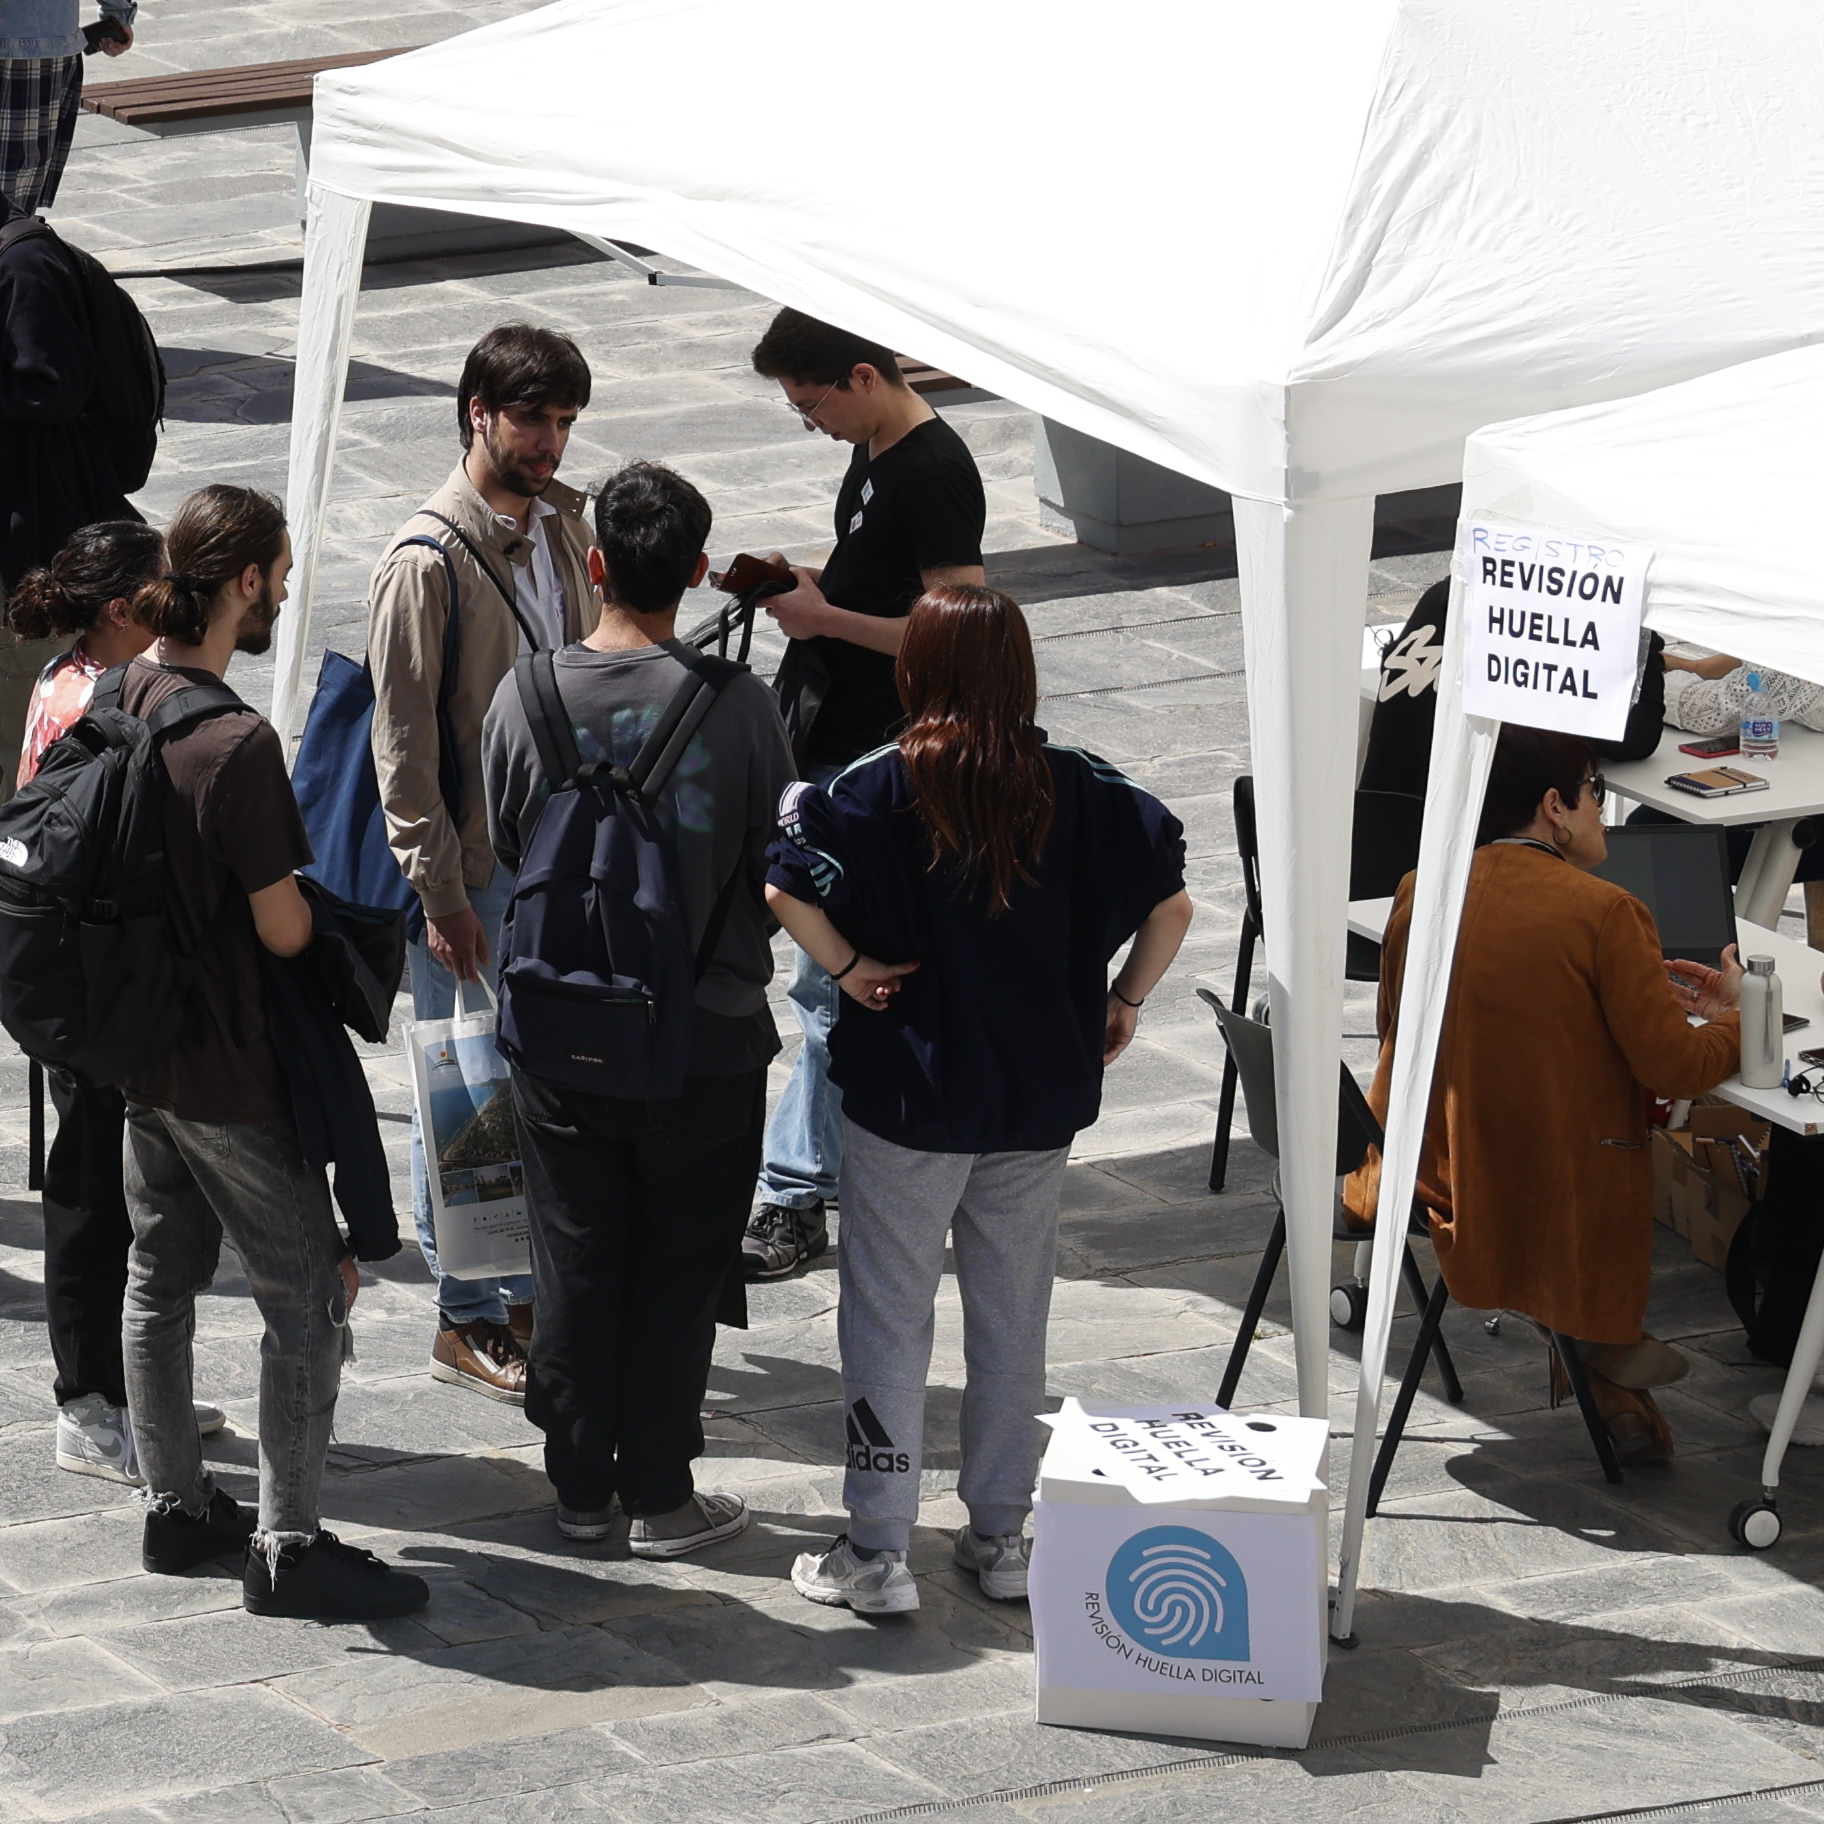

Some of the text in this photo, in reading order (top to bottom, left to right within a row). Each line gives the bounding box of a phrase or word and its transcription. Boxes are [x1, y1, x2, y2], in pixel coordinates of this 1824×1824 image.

[1472, 527, 1624, 568] REGISTRO
[1482, 556, 1625, 605] REVISIÓN
[1488, 605, 1600, 651] HUELLA
[1487, 653, 1598, 700] DIGITAL
[571, 1054, 603, 1063] EASTPAK
[847, 1442, 911, 1473] idas
[1089, 1422, 1179, 1481] DIGITAL
[1134, 1419, 1225, 1477] HUELLA
[1171, 1411, 1284, 1483] REVISIÓN
[1085, 1591, 1265, 1685] REVISIÓN HUELLA DIGITAL
